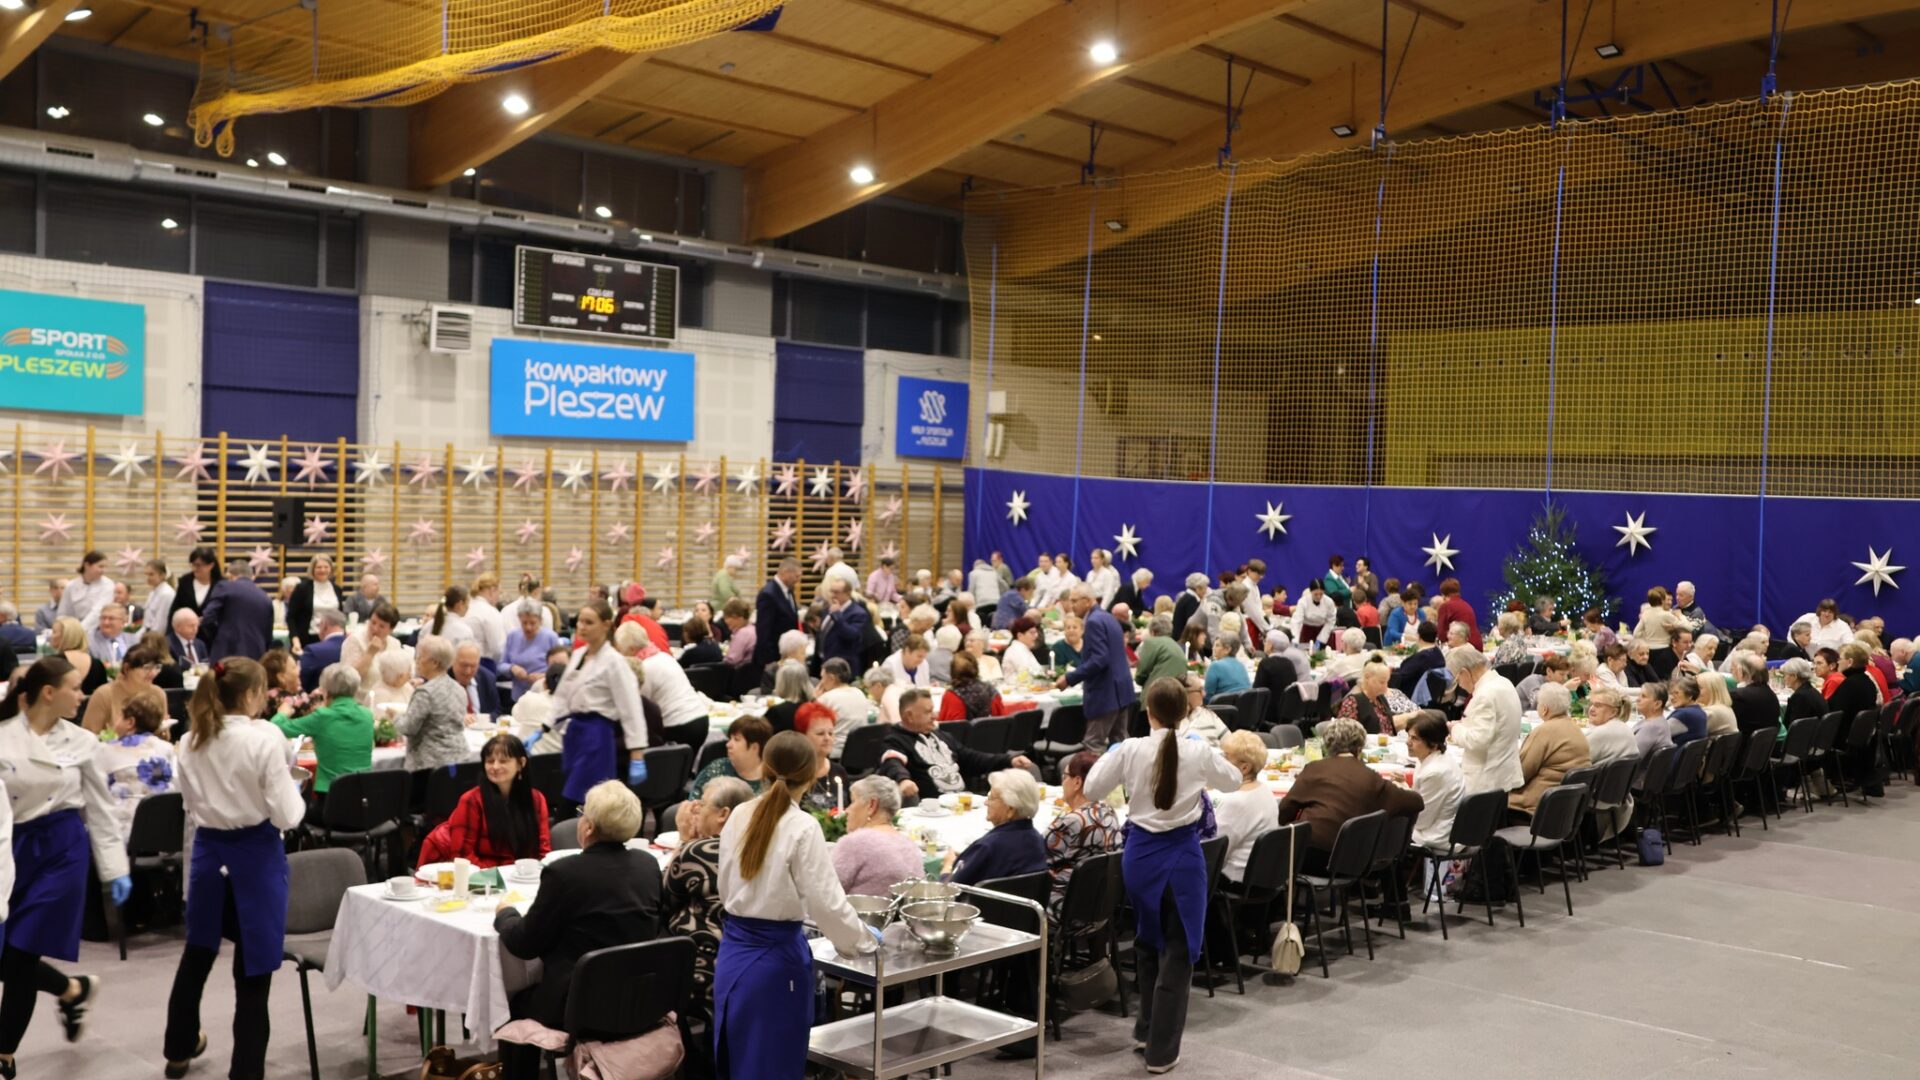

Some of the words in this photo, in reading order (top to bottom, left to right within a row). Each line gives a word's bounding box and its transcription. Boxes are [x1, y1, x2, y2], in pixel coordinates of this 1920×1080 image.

[31, 328, 107, 350] SPORT
[0, 354, 105, 379] PLESZEW
[524, 358, 668, 392] kompaktowy
[524, 381, 666, 421] Pleszew
